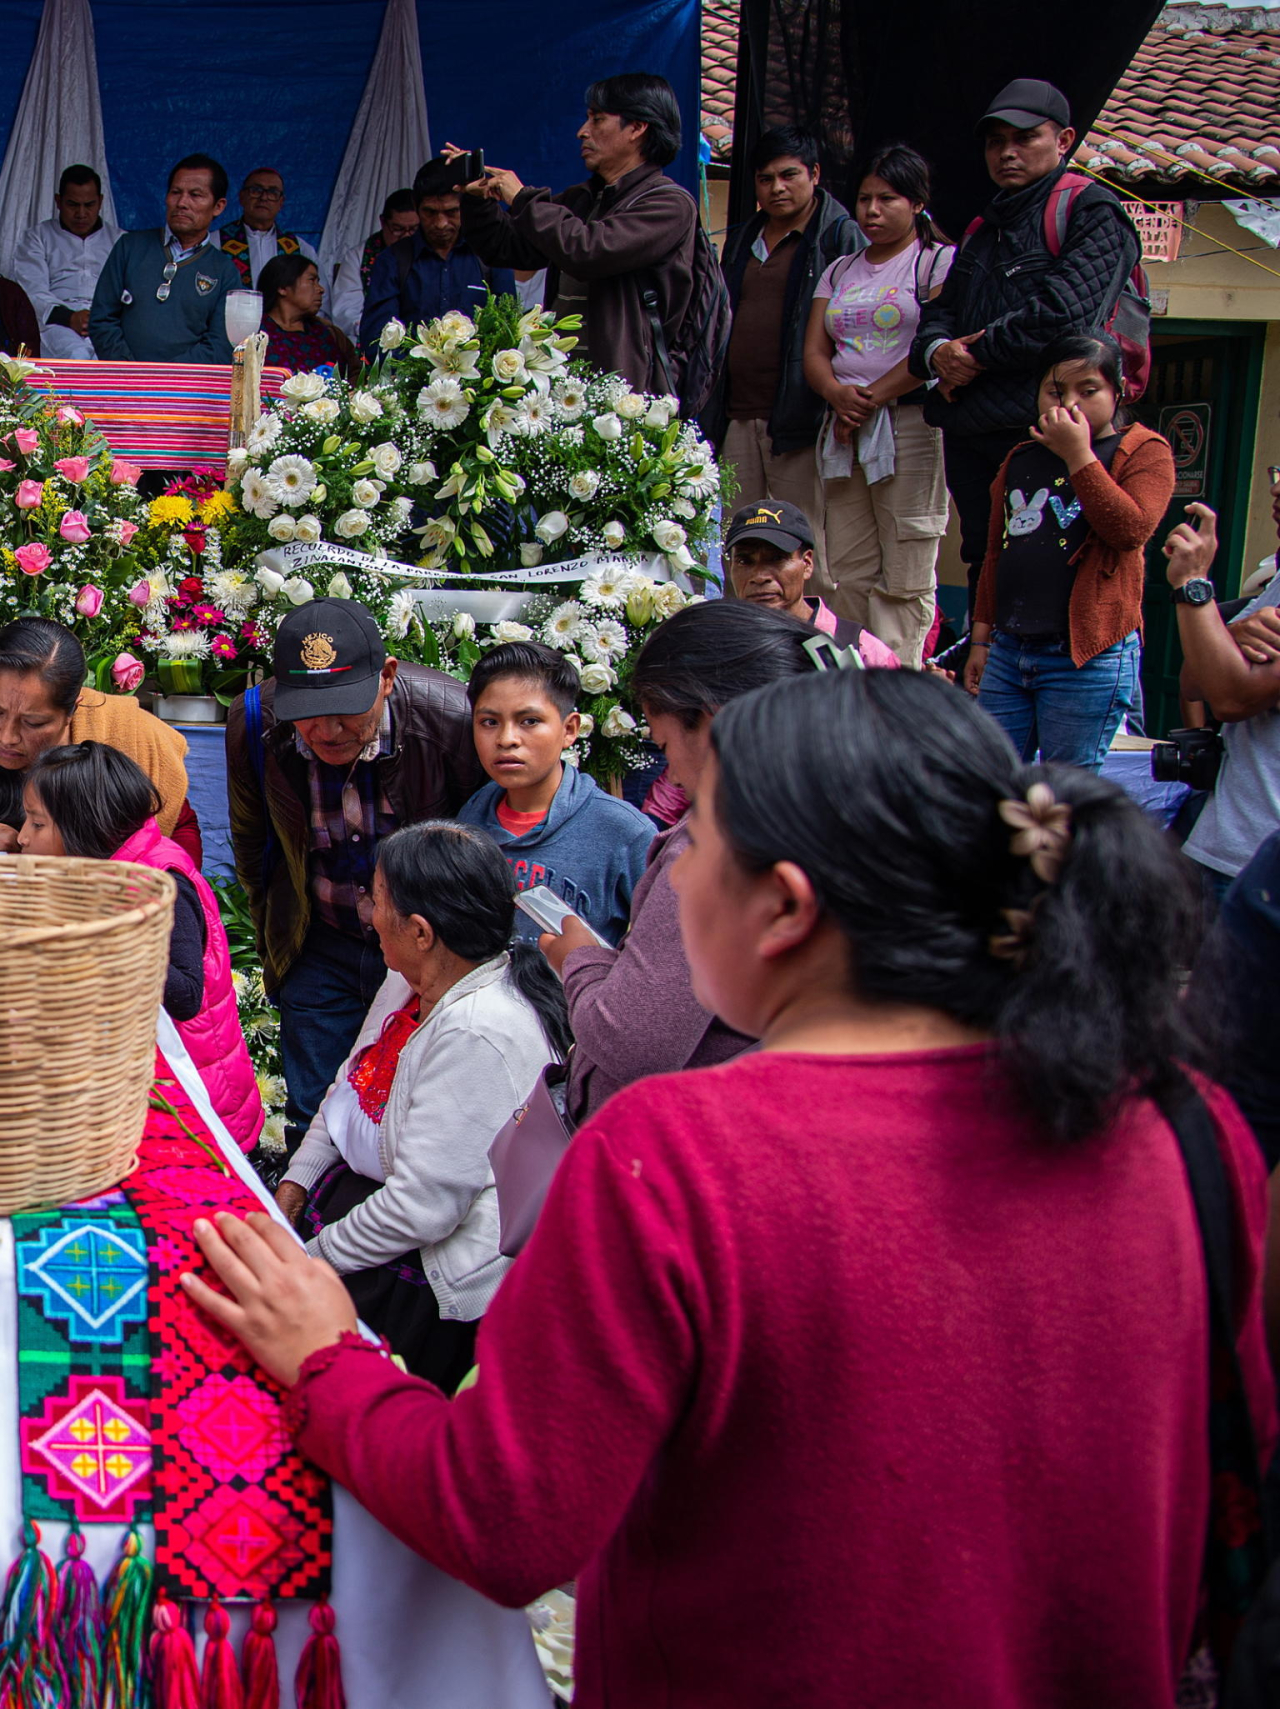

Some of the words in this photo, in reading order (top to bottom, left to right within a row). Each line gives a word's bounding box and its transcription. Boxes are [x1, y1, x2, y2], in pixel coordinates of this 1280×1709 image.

[283, 542, 356, 559] RECUERDO
[527, 560, 590, 579] LORENZO
[301, 632, 334, 646] MEXICO
